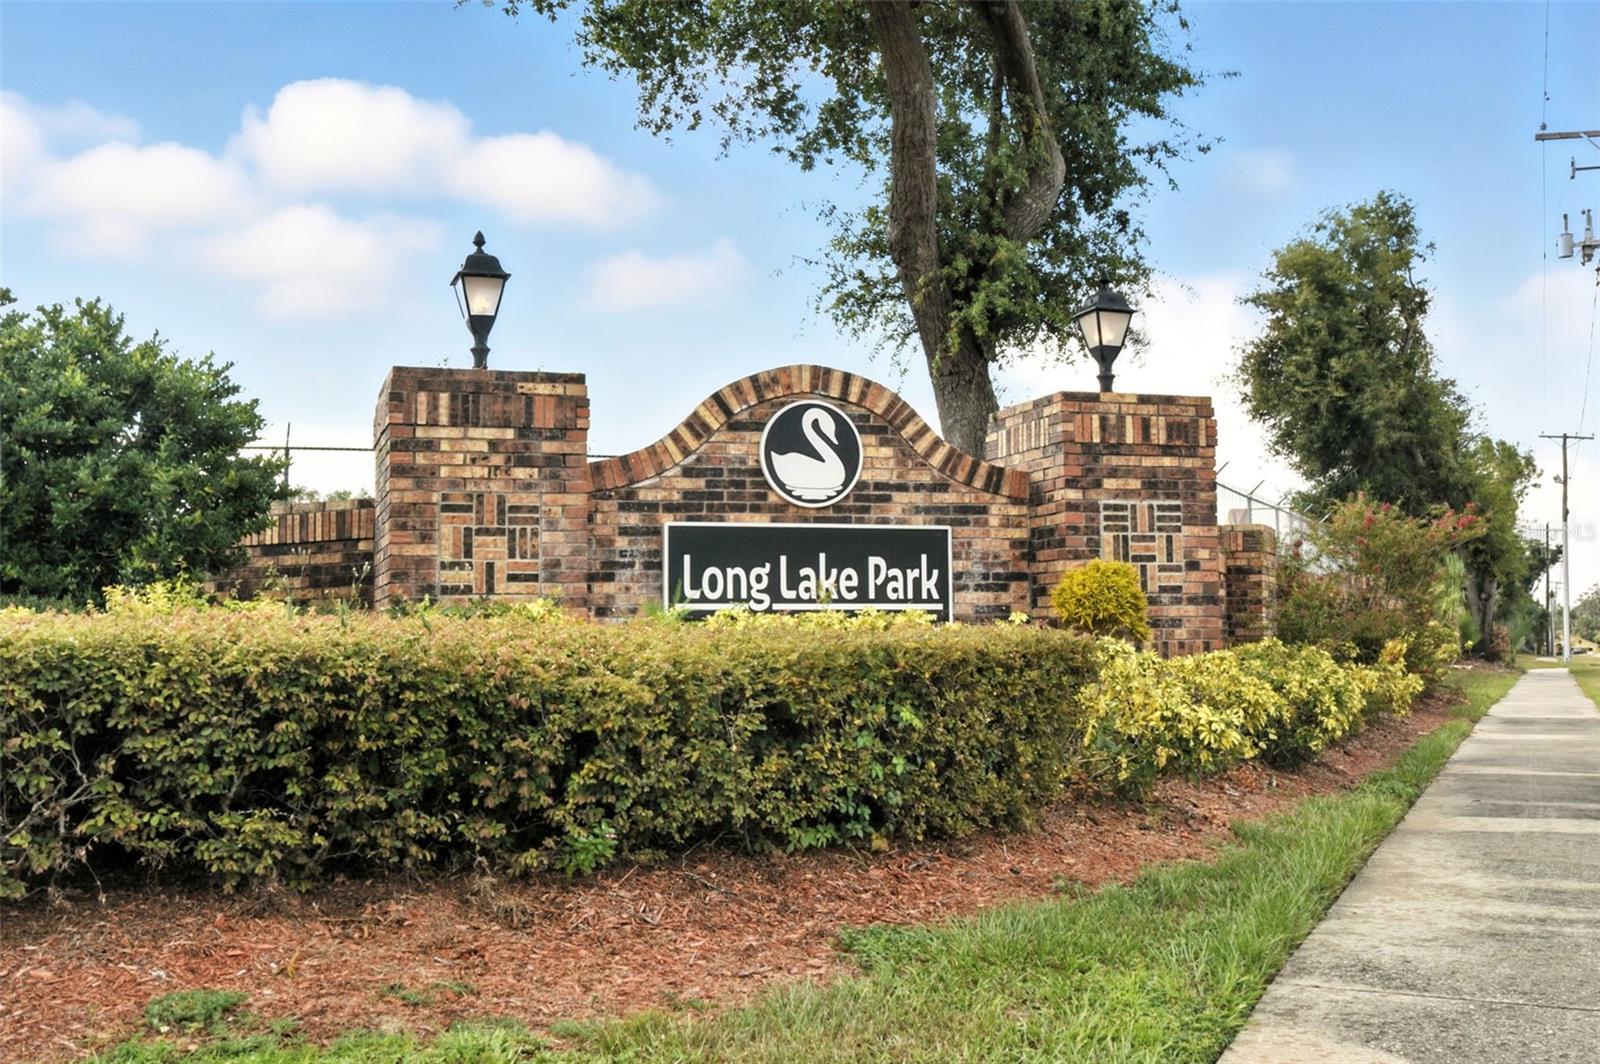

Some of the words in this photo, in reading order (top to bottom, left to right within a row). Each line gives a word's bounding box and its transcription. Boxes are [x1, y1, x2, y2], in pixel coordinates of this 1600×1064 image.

[683, 554, 771, 611] Long
[780, 552, 859, 600] Lake
[868, 553, 940, 600] Park
